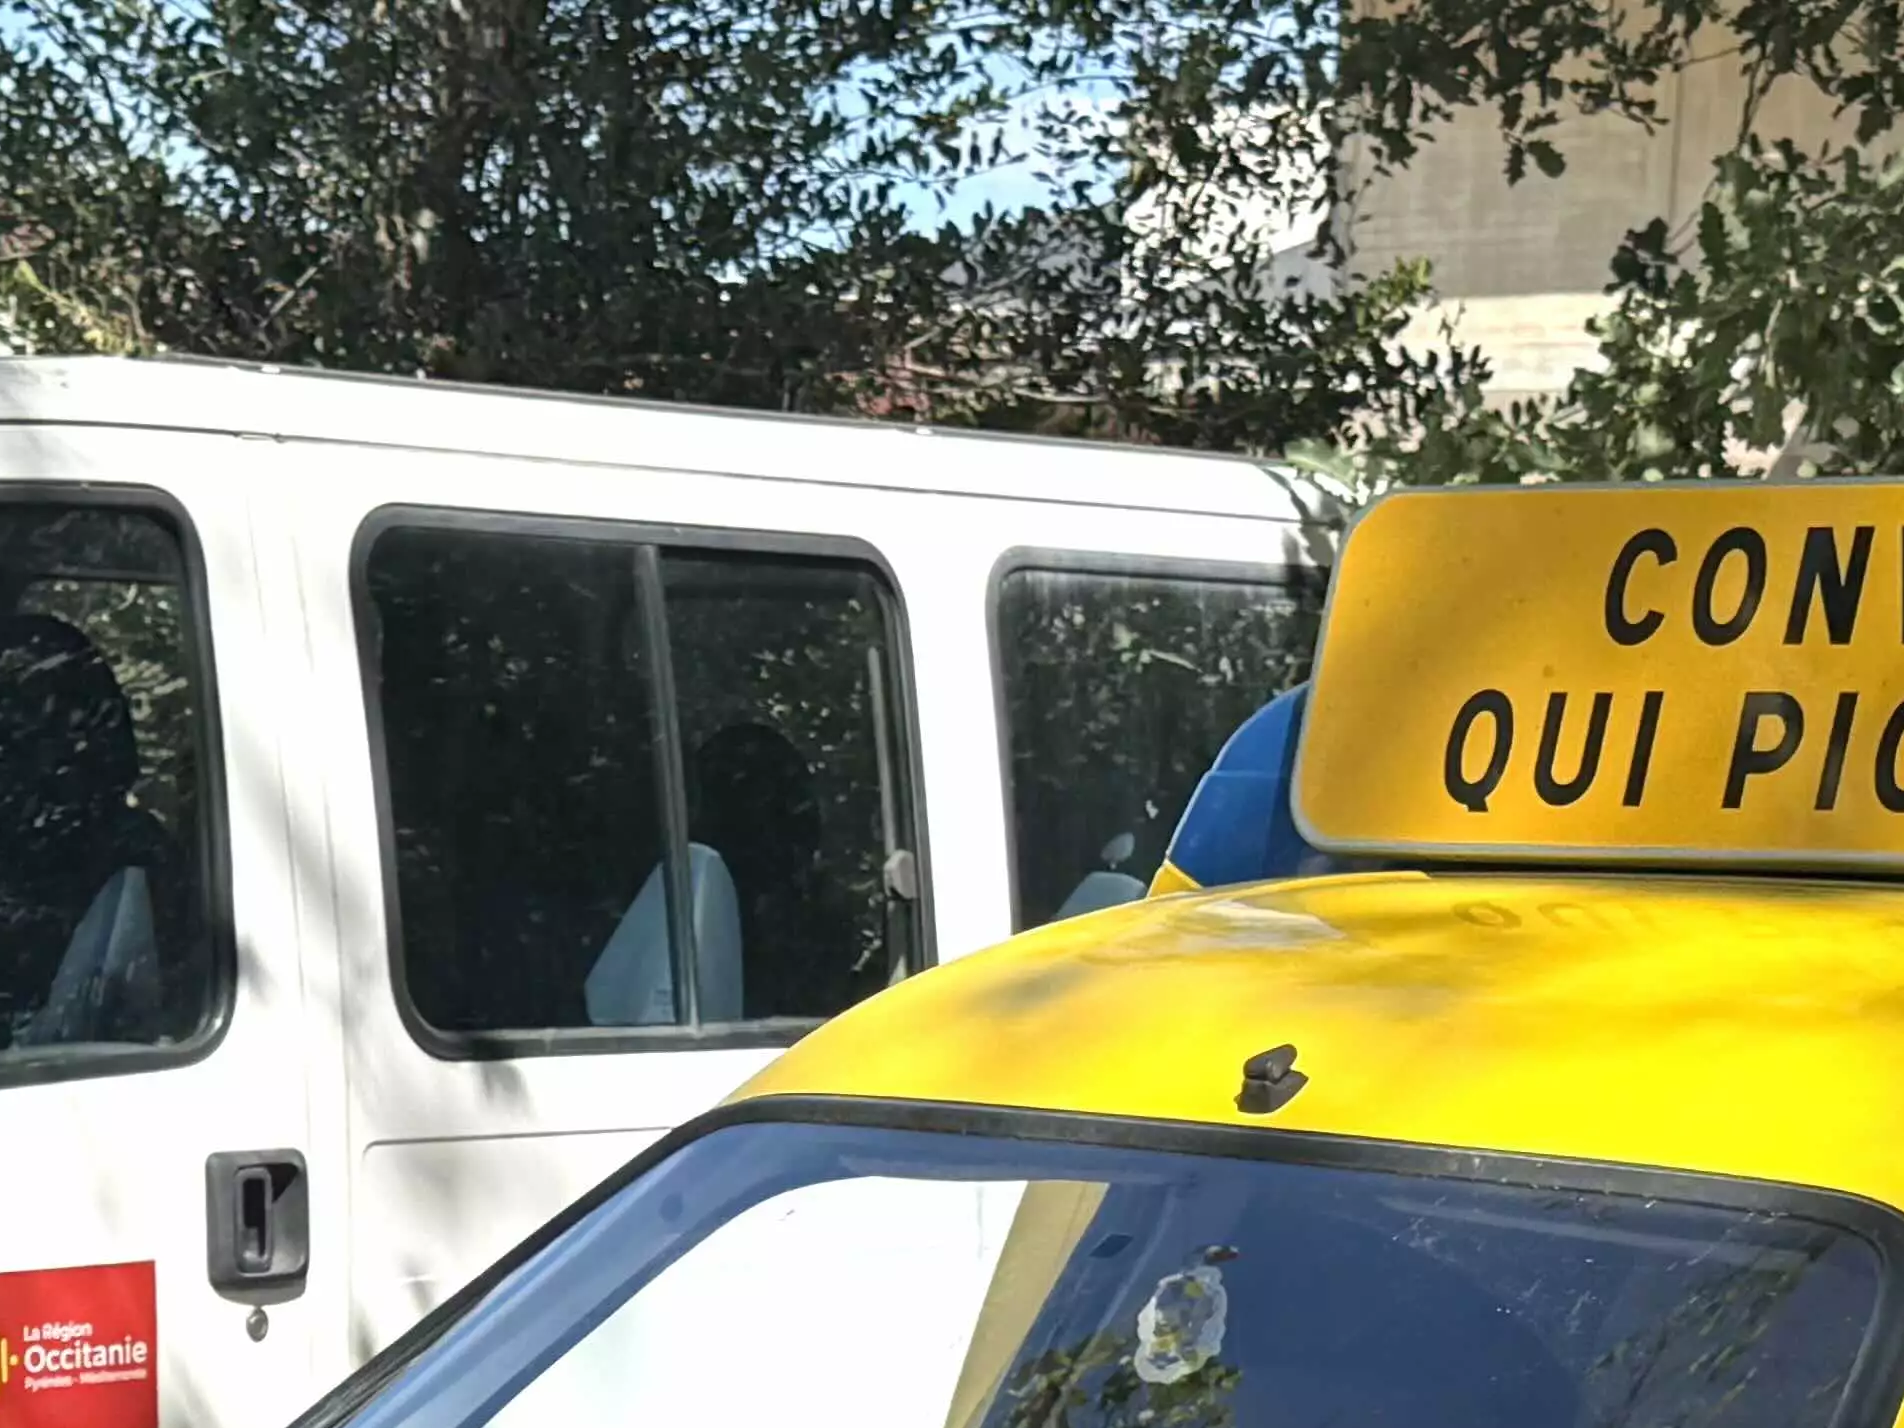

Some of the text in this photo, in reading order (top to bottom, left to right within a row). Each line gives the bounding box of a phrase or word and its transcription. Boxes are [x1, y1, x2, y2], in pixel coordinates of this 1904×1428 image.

[1442, 688, 1665, 814] QUI
[23, 1325, 41, 1342] La
[24, 1334, 148, 1373] Occitanie
